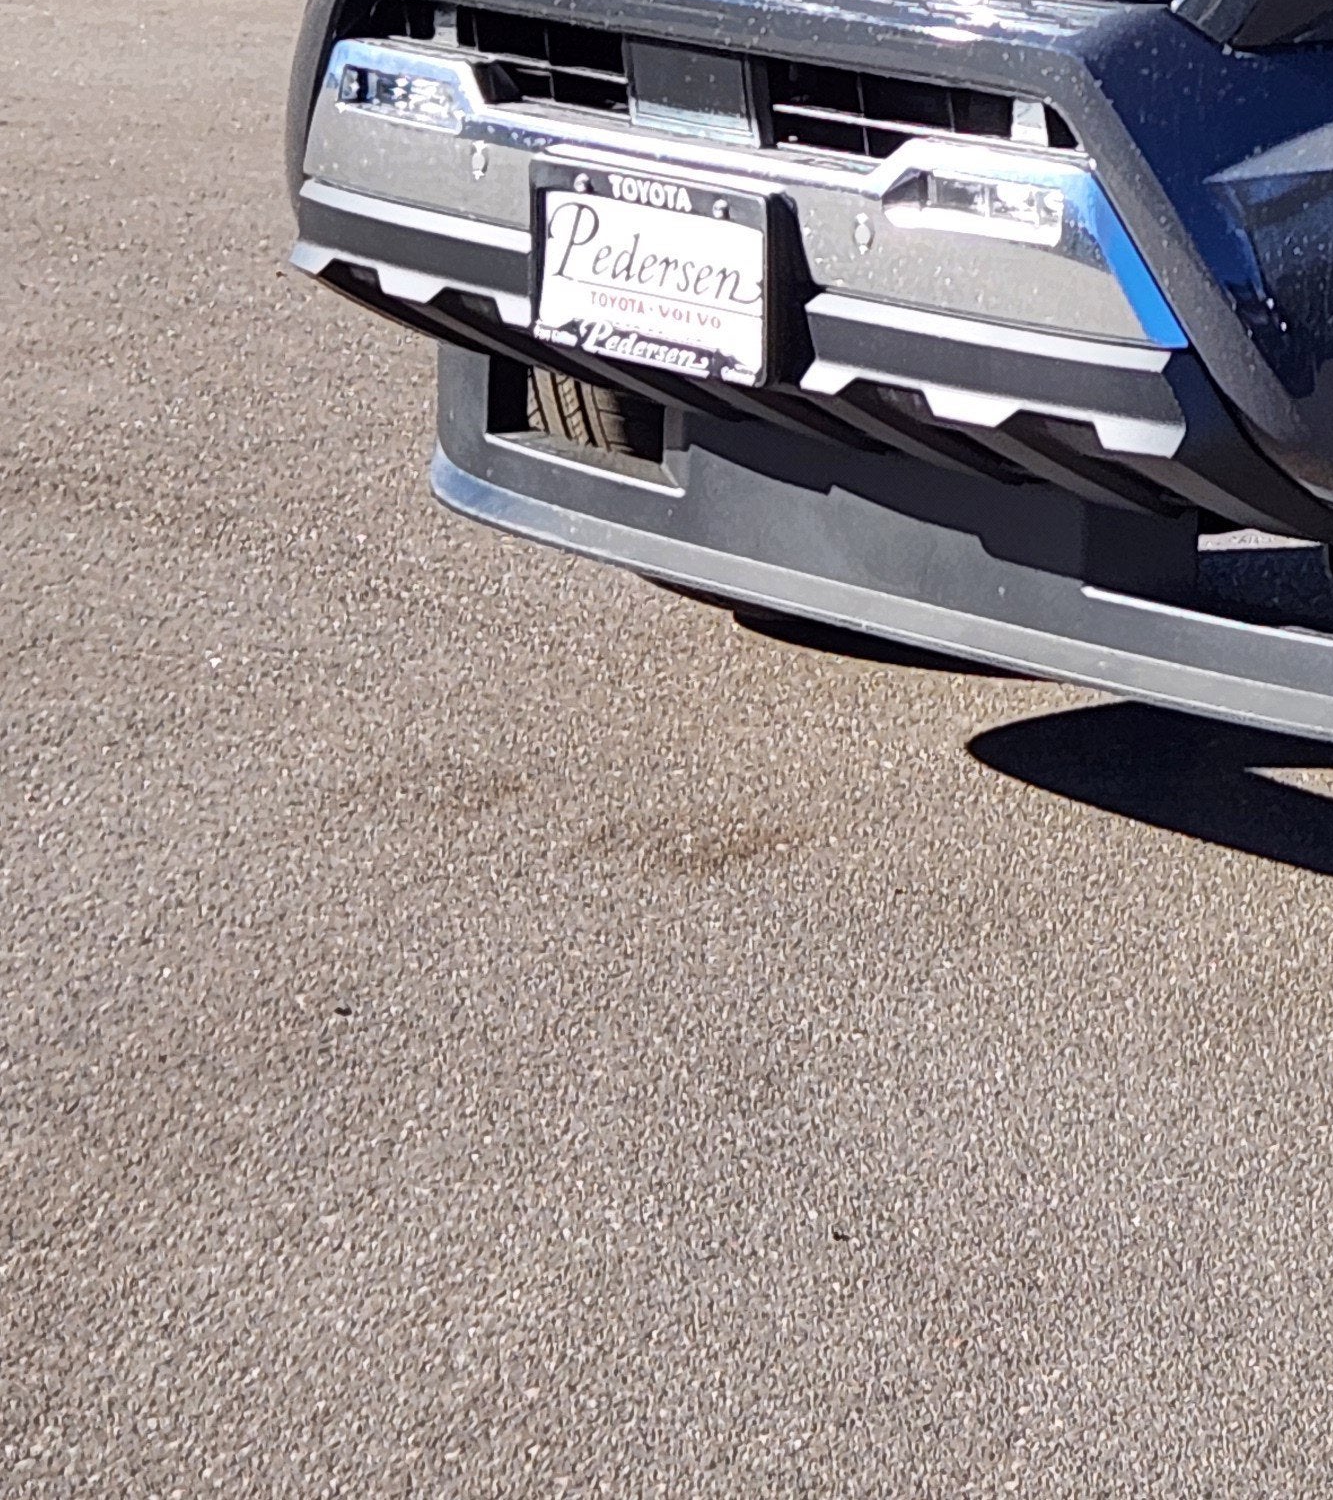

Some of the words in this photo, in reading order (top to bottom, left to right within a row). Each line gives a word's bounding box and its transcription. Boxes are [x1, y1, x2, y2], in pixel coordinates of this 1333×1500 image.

[608, 173, 692, 212] TOYOTA
[548, 201, 763, 304] Pedersen
[590, 290, 645, 315] TOYOTA
[579, 319, 709, 374] Pedersen
